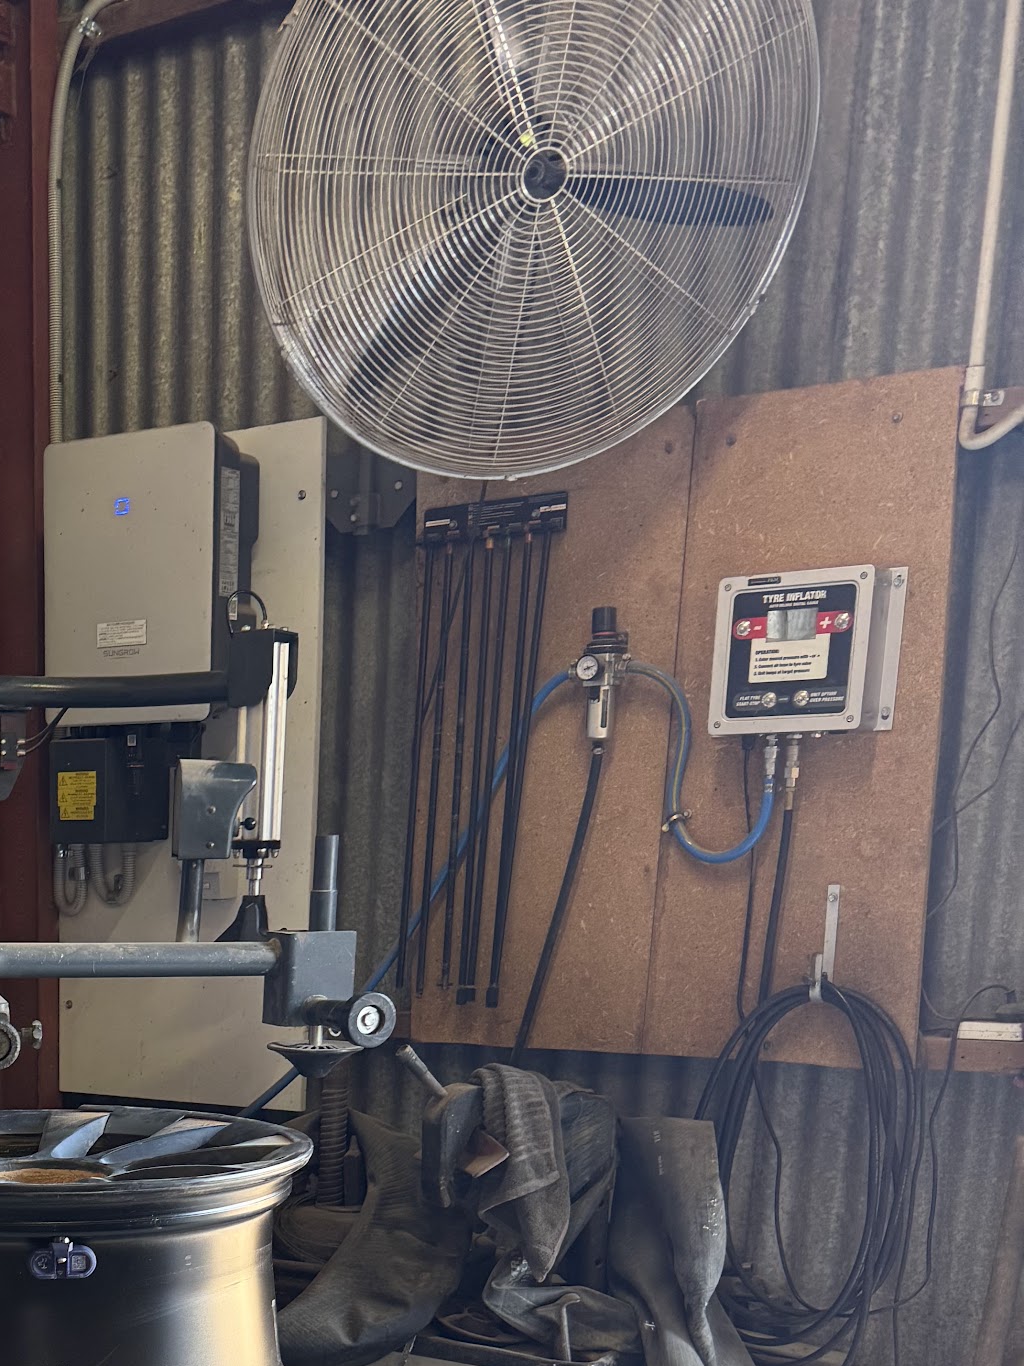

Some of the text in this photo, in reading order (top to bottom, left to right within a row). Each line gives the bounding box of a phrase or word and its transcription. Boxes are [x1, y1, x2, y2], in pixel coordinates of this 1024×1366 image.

[762, 590, 827, 604] TYRE INFLATOR
[103, 648, 140, 657] SUNGROW
